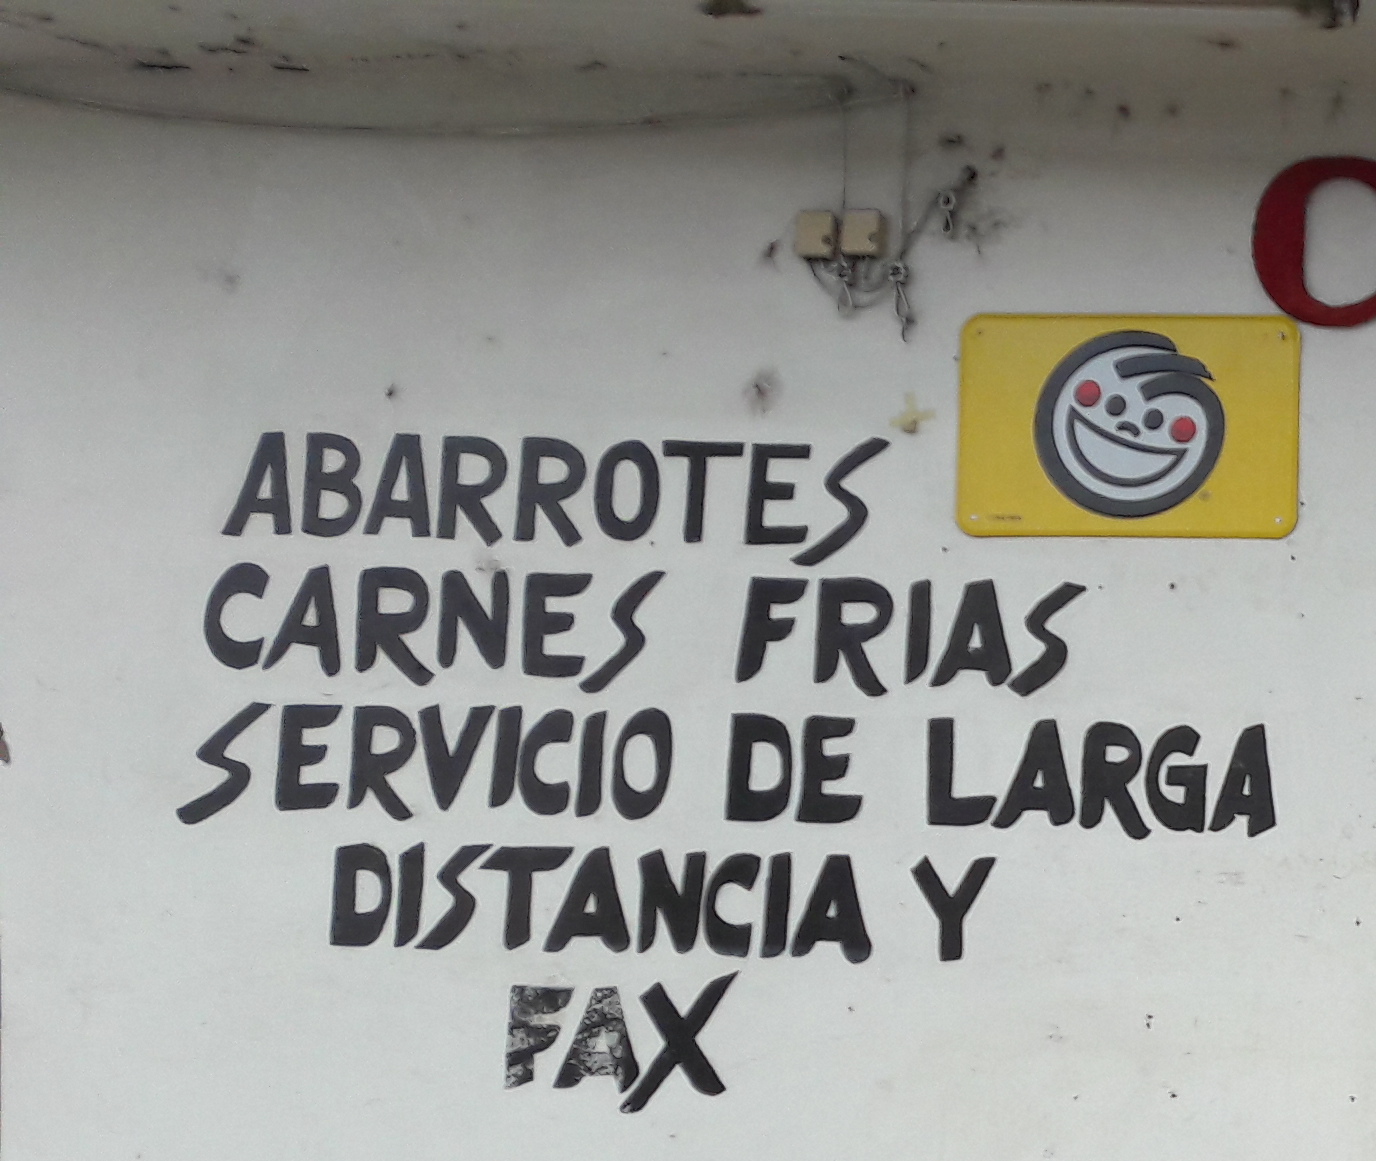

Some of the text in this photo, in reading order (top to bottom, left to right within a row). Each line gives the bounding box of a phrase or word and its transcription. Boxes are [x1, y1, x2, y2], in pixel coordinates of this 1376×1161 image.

[220, 431, 890, 567] ABARROTES
[203, 562, 1087, 698] CARNES FRIAS
[174, 701, 1277, 840] SERVICIO DE LARGA
[329, 842, 998, 966] DISTANCIA Y
[502, 970, 741, 1115] FAX
